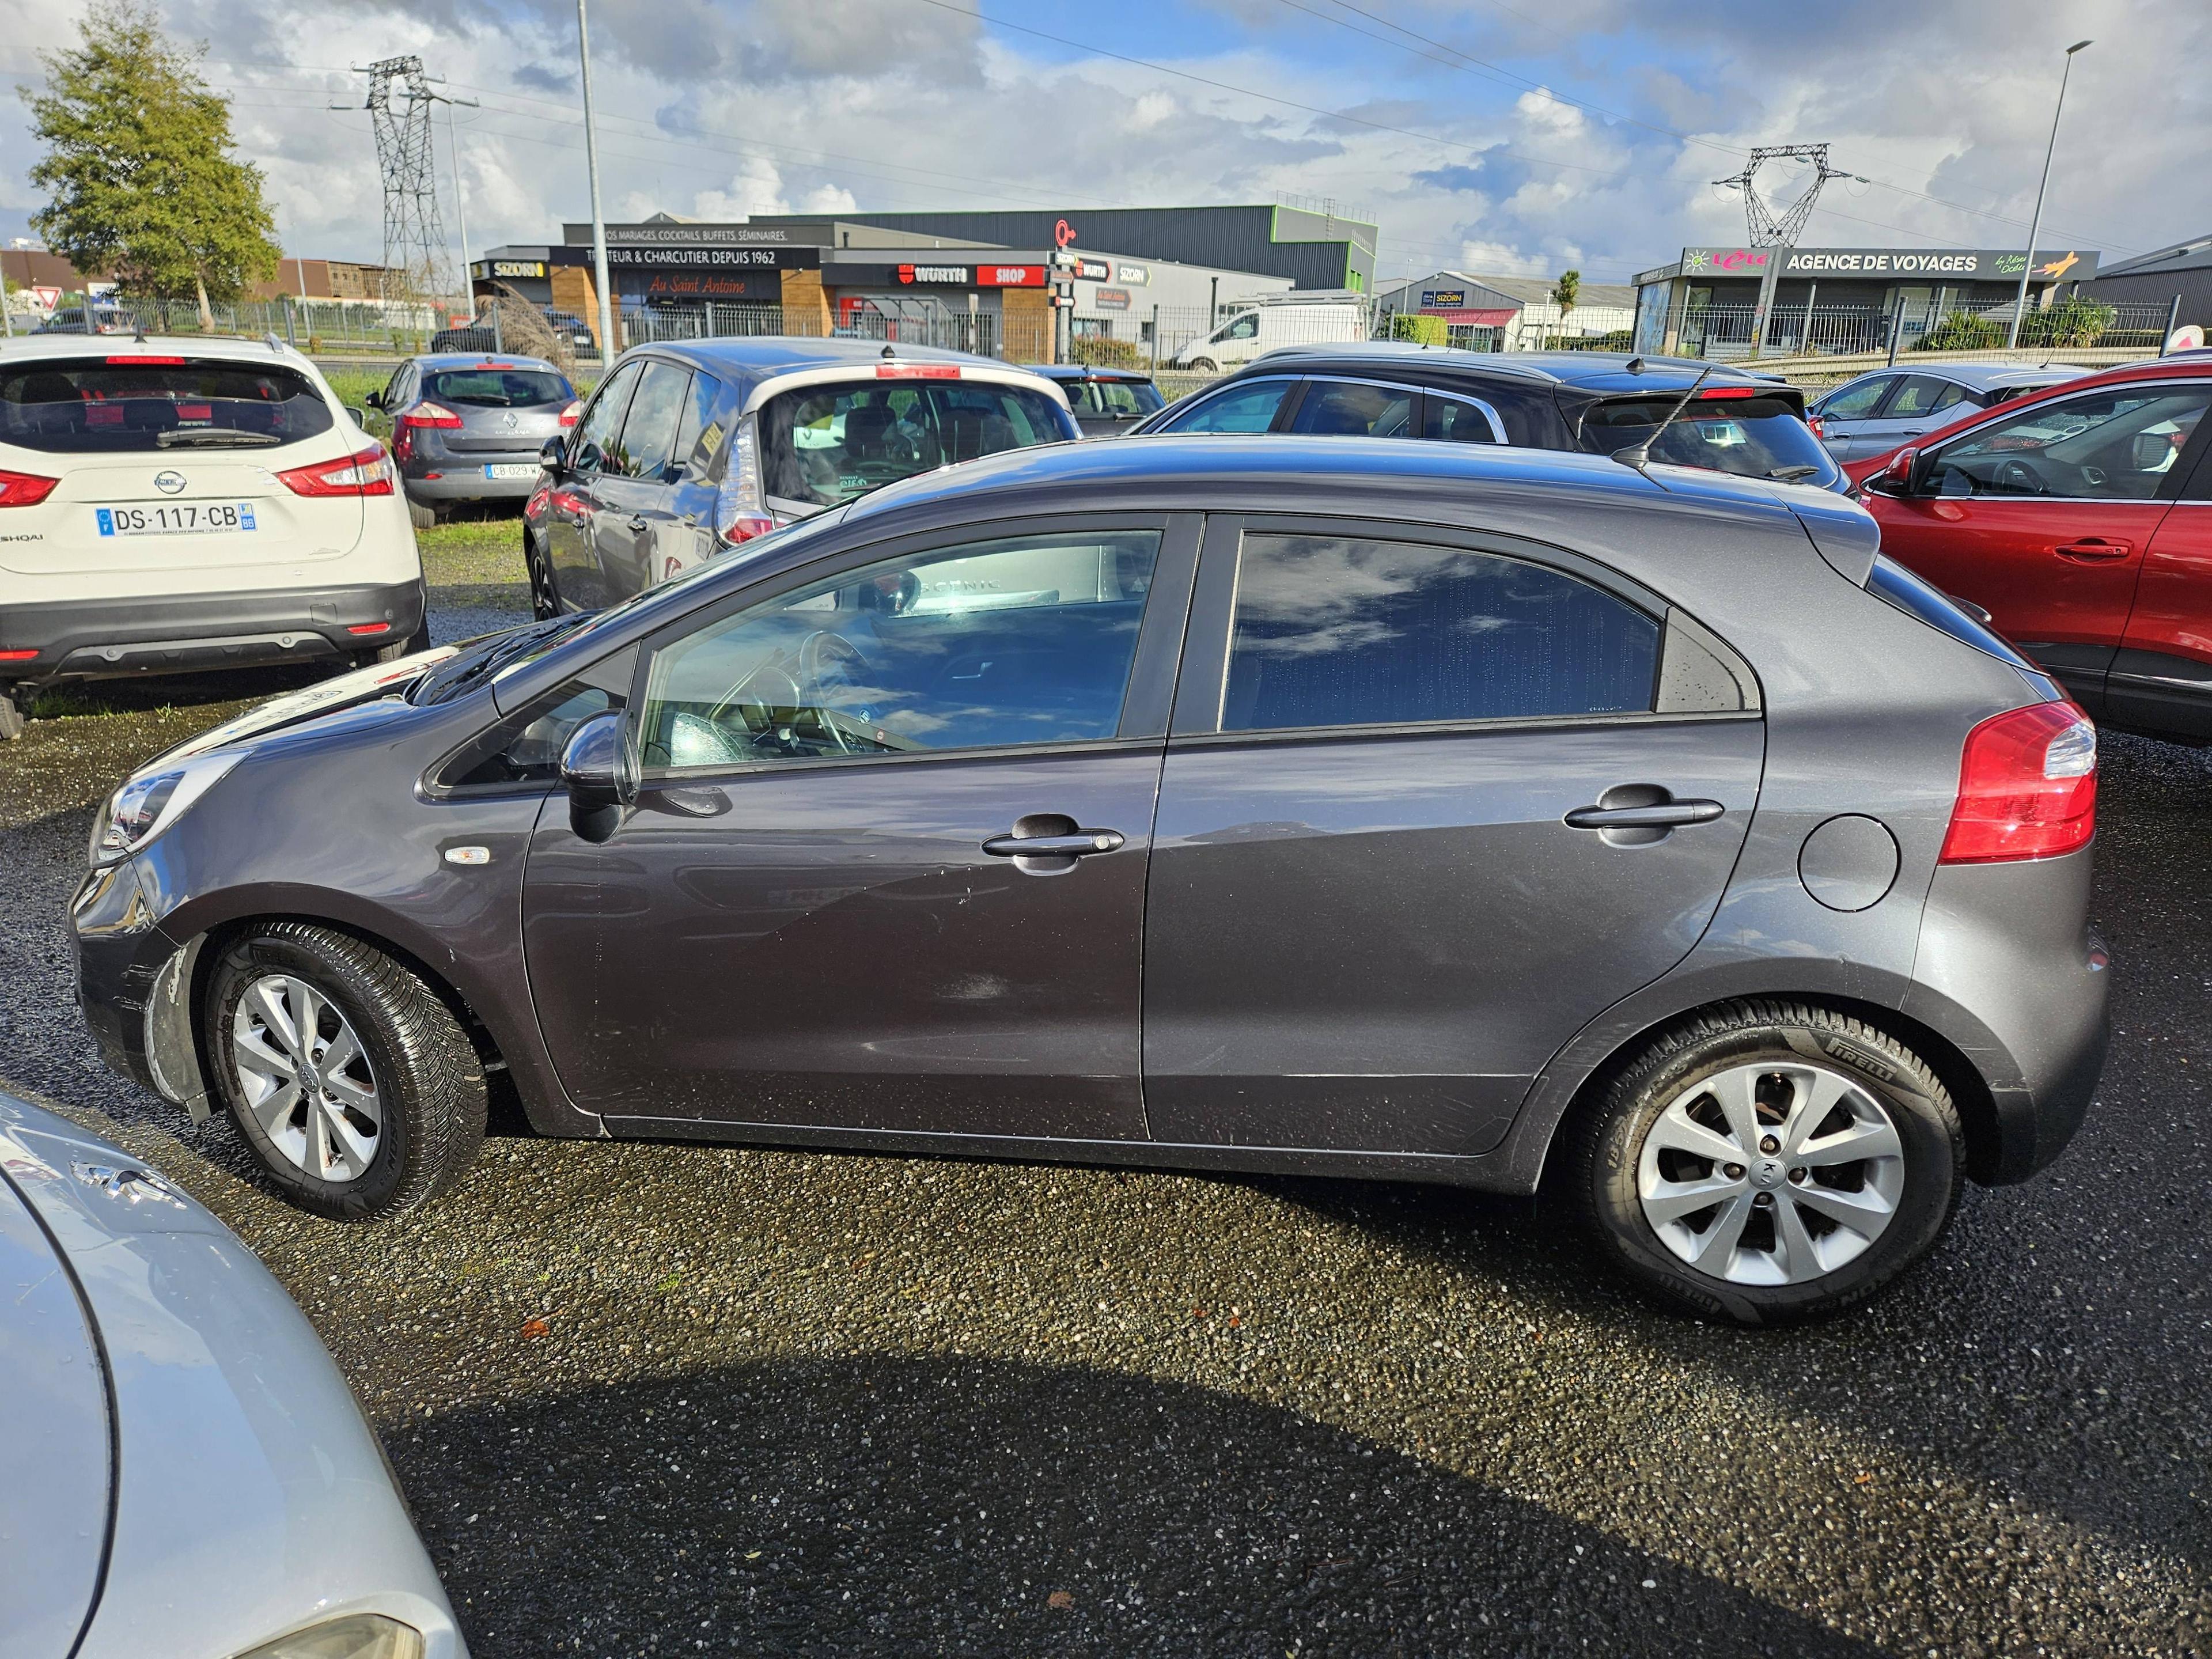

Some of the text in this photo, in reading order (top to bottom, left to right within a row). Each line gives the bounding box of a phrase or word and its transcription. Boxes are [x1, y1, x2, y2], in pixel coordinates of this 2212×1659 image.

[606, 230, 617, 240] OS
[635, 250, 642, 263] &
[644, 250, 710, 264] CHARCUTIER
[711, 251, 749, 264] DEPUIS
[751, 251, 775, 264] 1962
[1787, 255, 1977, 271] AGENCE DE VOYAGES
[996, 268, 1026, 283] SHOP
[649, 275, 745, 294] Au Saint Antoine
[115, 506, 237, 530] DS-117-CB
[1825, 1037, 1897, 1081] PIRELLI
